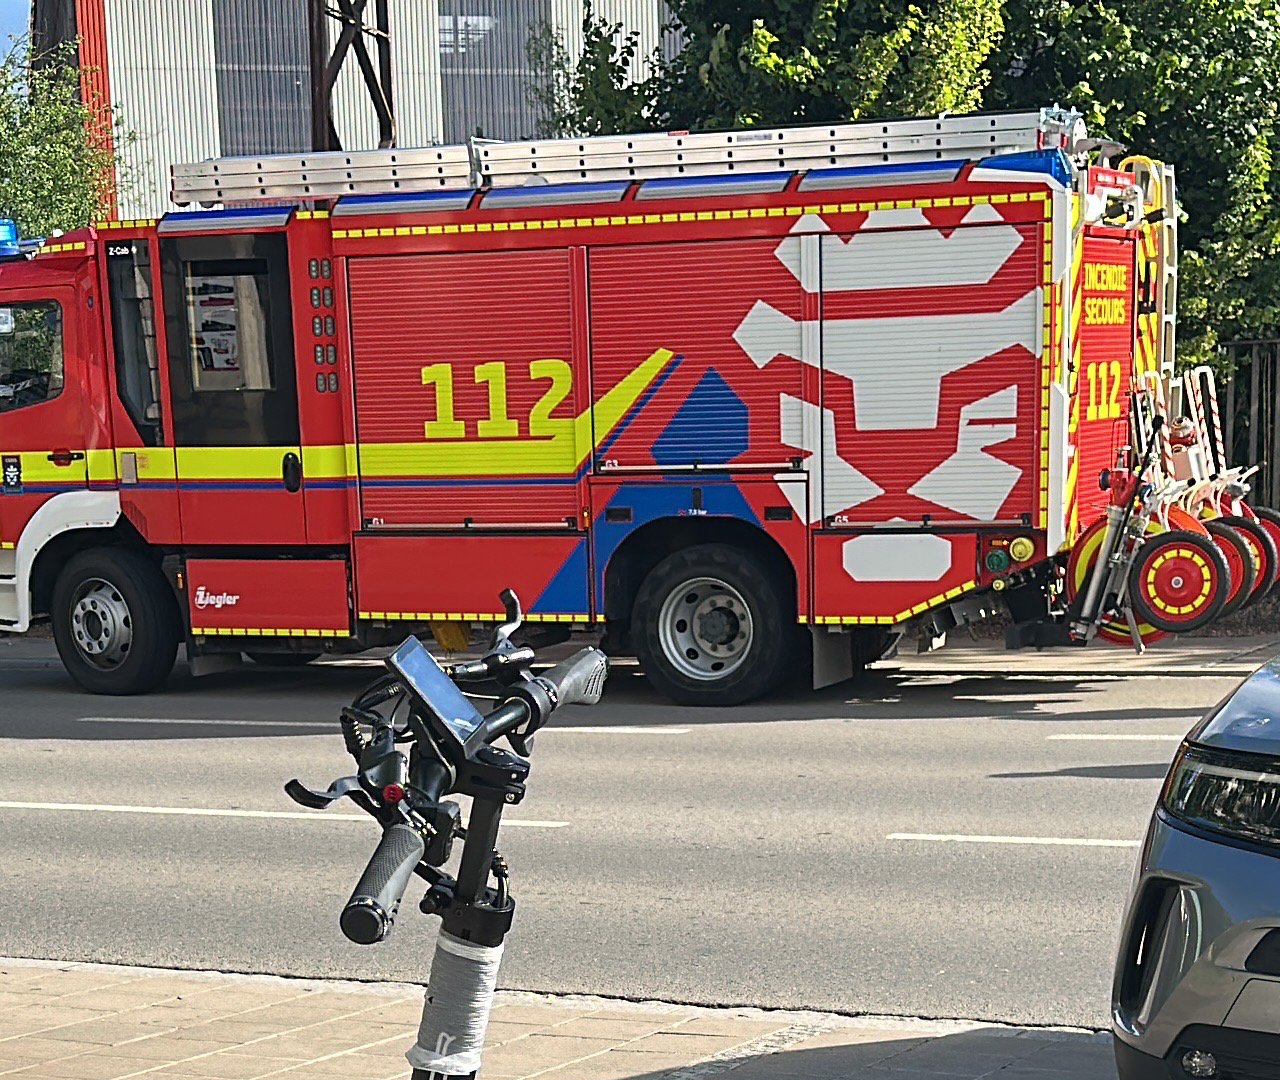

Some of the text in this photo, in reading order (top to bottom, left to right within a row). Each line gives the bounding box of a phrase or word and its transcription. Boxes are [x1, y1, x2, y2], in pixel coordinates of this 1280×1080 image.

[108, 246, 129, 256] Z-Cab
[1084, 262, 1127, 291] INCENDIE
[1085, 298, 1126, 325] SECOURS
[421, 359, 573, 439] 112
[1087, 360, 1121, 421] 112
[194, 586, 240, 610] Ziegler
